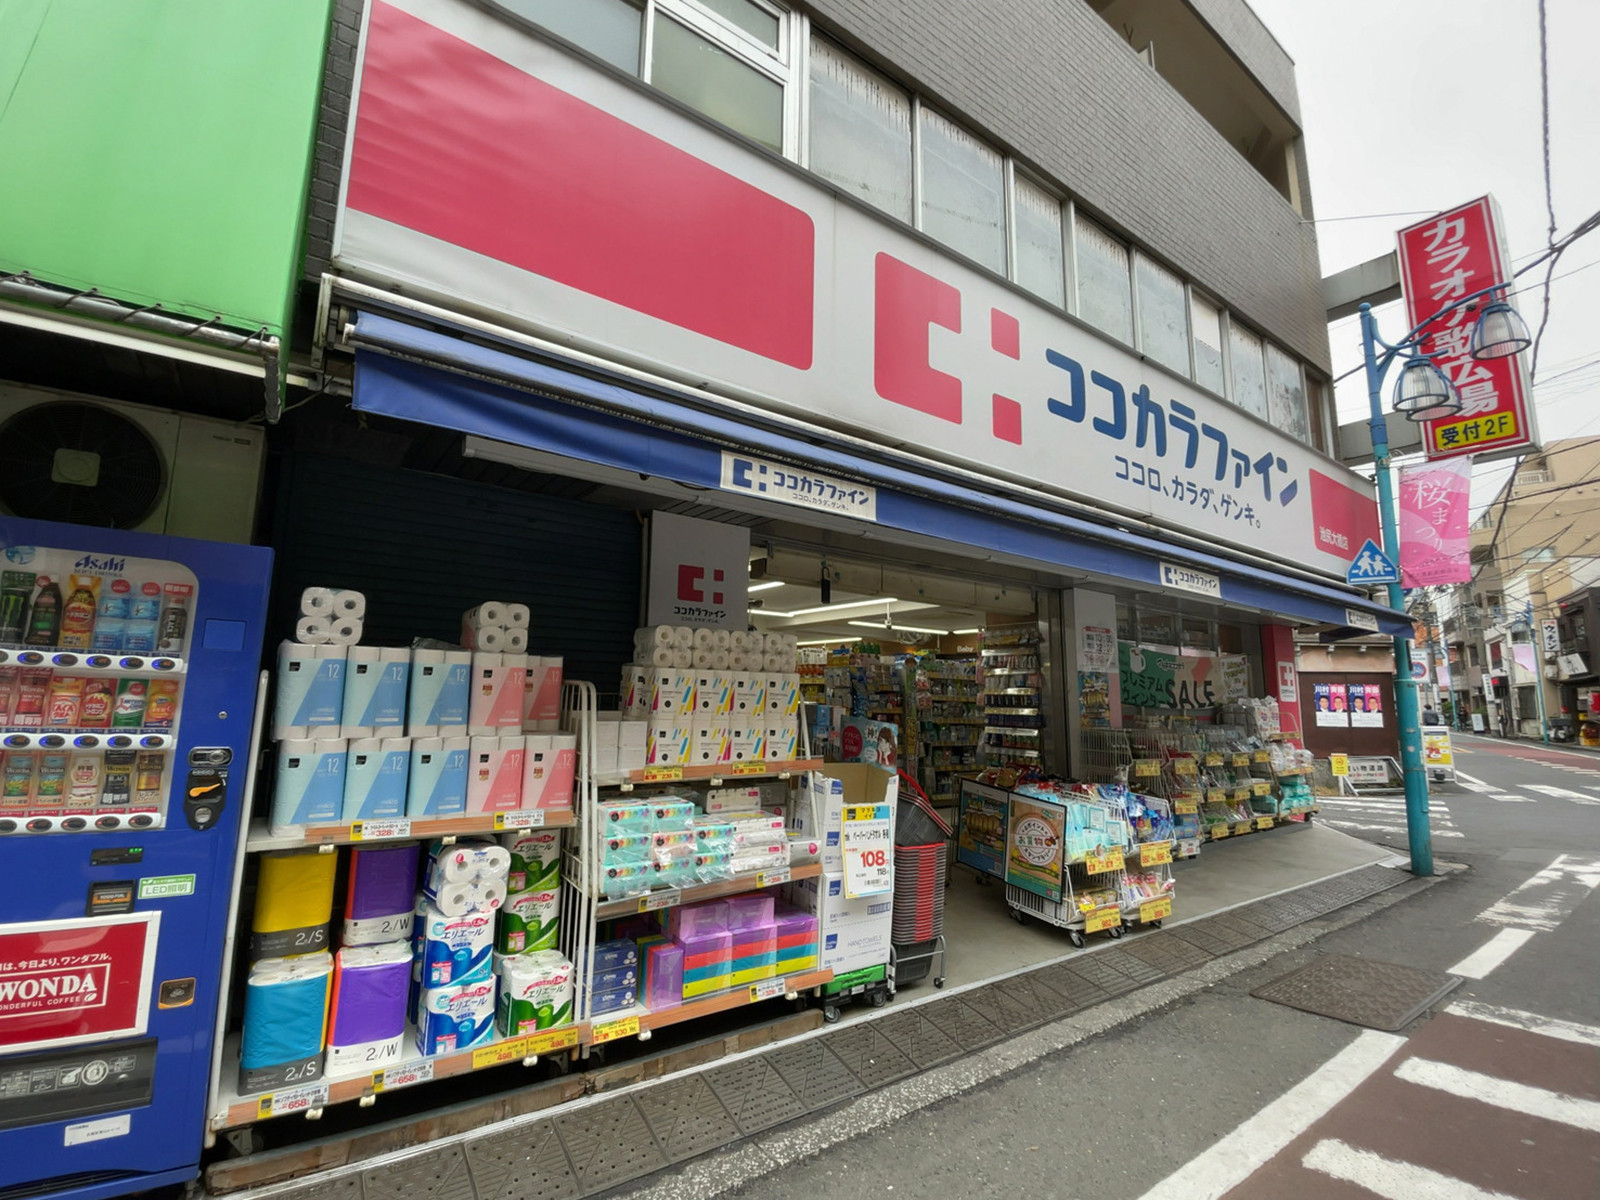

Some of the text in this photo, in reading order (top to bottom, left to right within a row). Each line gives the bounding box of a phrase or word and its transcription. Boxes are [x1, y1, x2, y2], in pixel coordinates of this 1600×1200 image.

[1045, 347, 1298, 507] ココカラファイン
[1440, 415, 1508, 447] 受付2F
[773, 470, 869, 505] ココカラファイン
[1114, 454, 1261, 529] ココロ、カラダ、ゲンキ。
[1412, 477, 1454, 552] 桜まつり
[74, 554, 126, 572] Asahi
[1178, 571, 1217, 589] ココカラファイン
[673, 606, 727, 619] ココカラファイン
[327, 663, 340, 679] 12
[391, 666, 404, 681] 12
[456, 668, 466, 682] 12
[1165, 678, 1216, 709] SALE
[327, 757, 340, 773] 12
[391, 755, 404, 771] 12
[454, 754, 465, 768] 12
[516, 842, 554, 852] エリエール
[860, 850, 885, 867] 108
[145, 883, 188, 895] LED照明
[516, 902, 553, 912] エリエール
[441, 928, 485, 939] エリエール
[0, 953, 113, 971] は、今日より、ワンダフル。
[0, 973, 98, 1002] WONDA
[527, 985, 565, 998] エリエール
[47, 996, 81, 1006] COFFEE
[445, 997, 488, 1012] エリエール
[287, 1098, 307, 1110] 658
